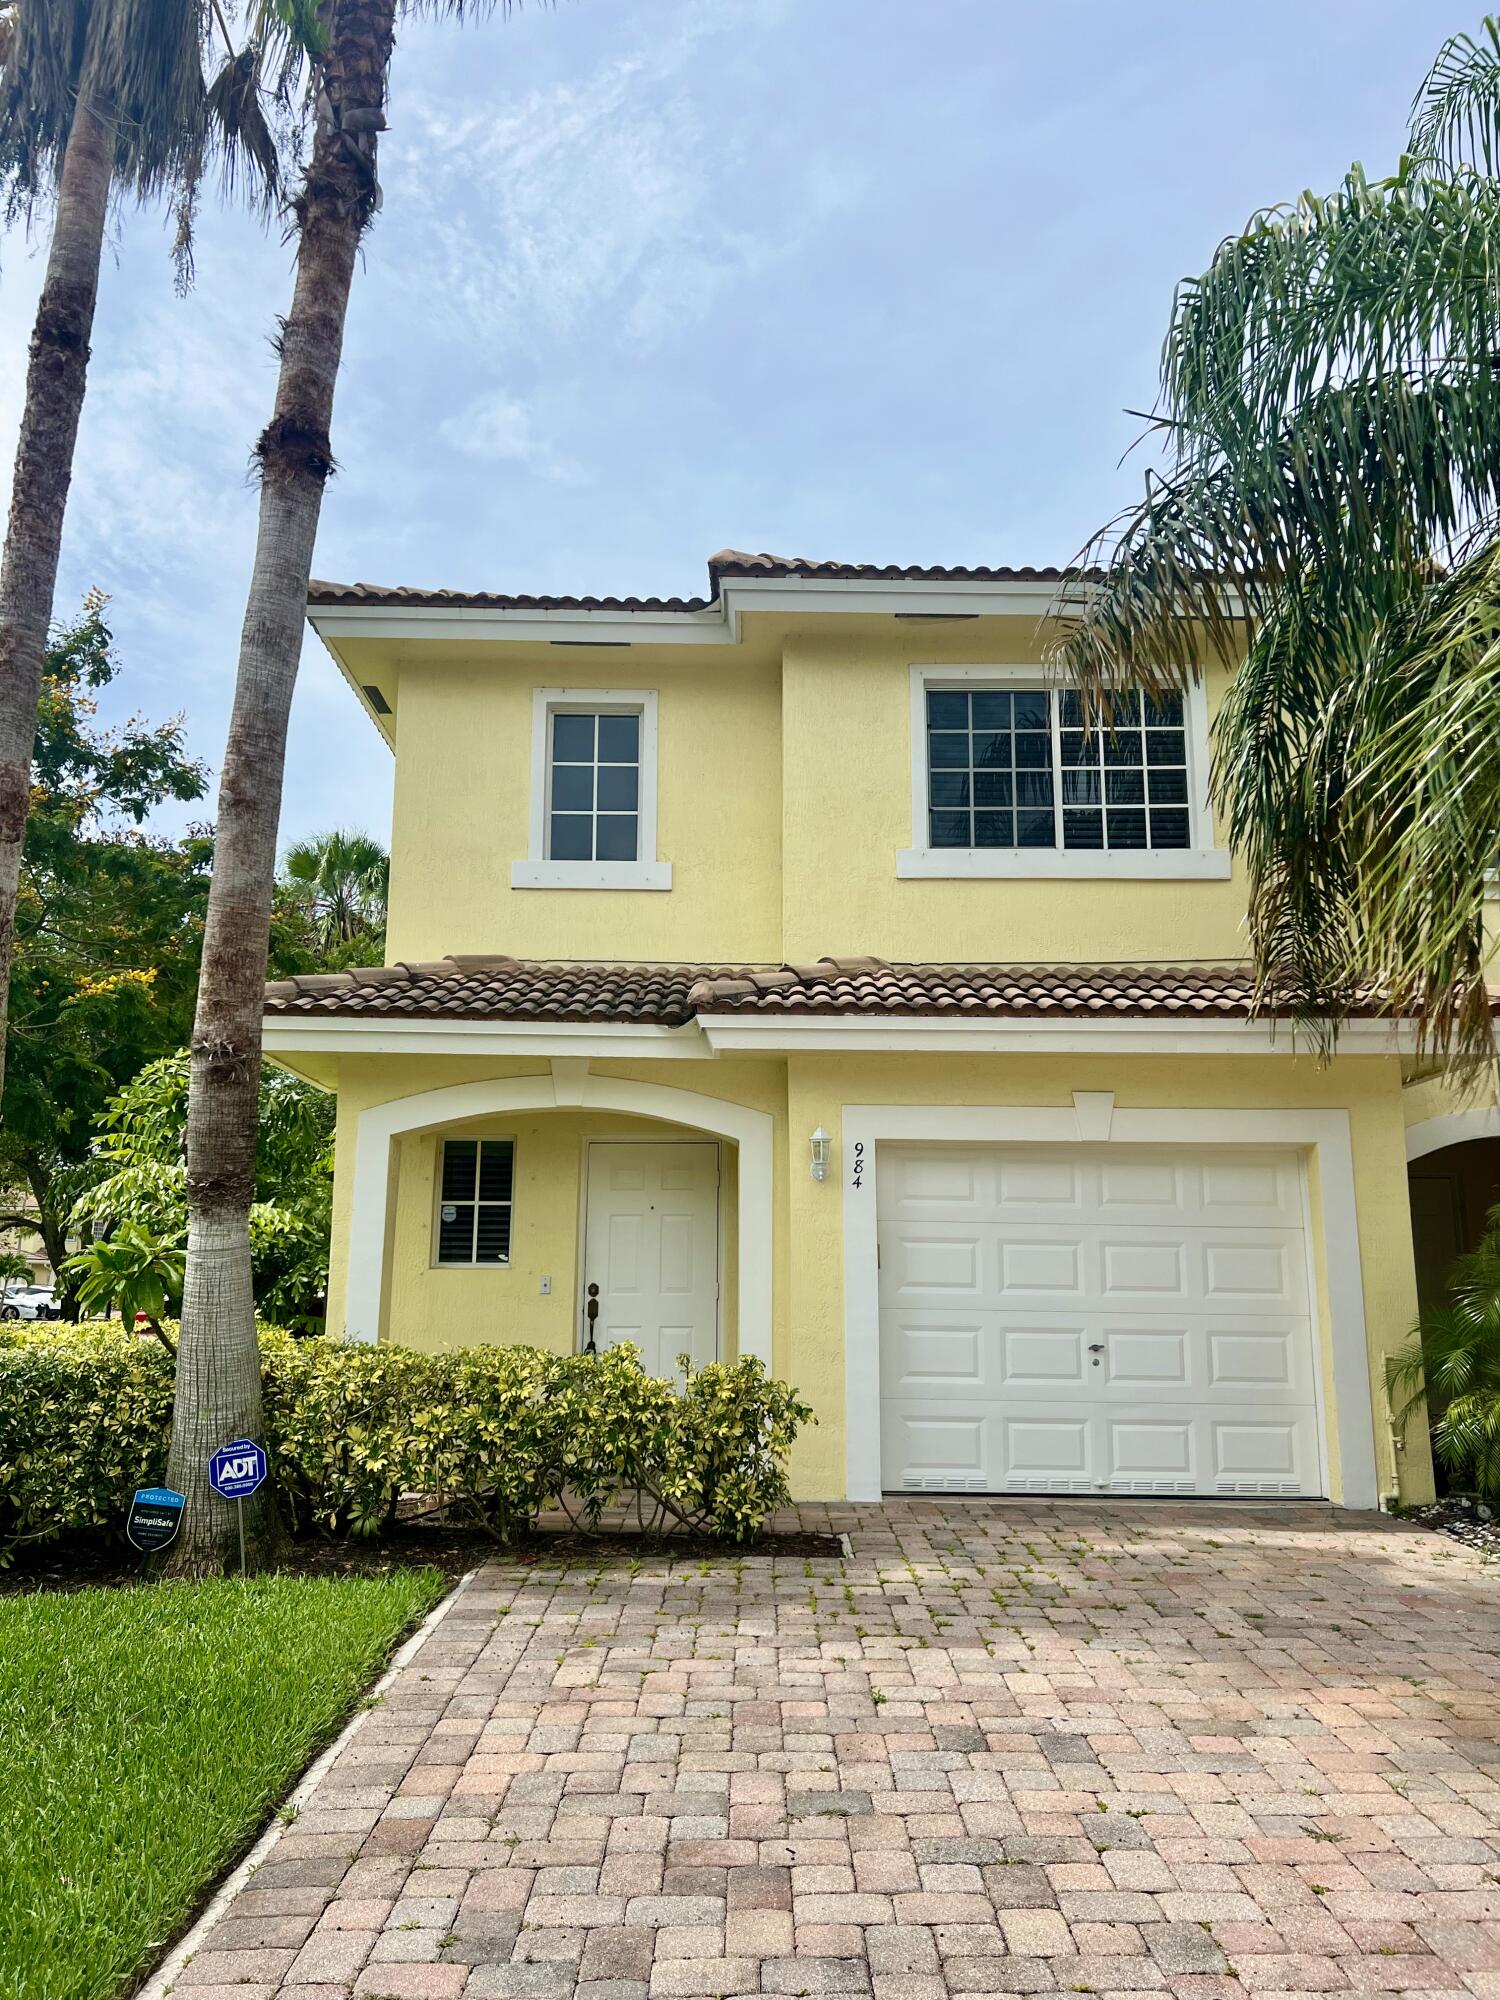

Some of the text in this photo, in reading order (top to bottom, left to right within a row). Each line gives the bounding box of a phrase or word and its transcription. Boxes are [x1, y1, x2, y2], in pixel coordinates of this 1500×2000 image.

[852, 1142, 864, 1189] 984
[222, 1444, 243, 1452] Secured
[219, 1456, 257, 1481] ADT
[141, 1493, 179, 1503] PROTECTED
[133, 1515, 174, 1528] SimpliSafe
